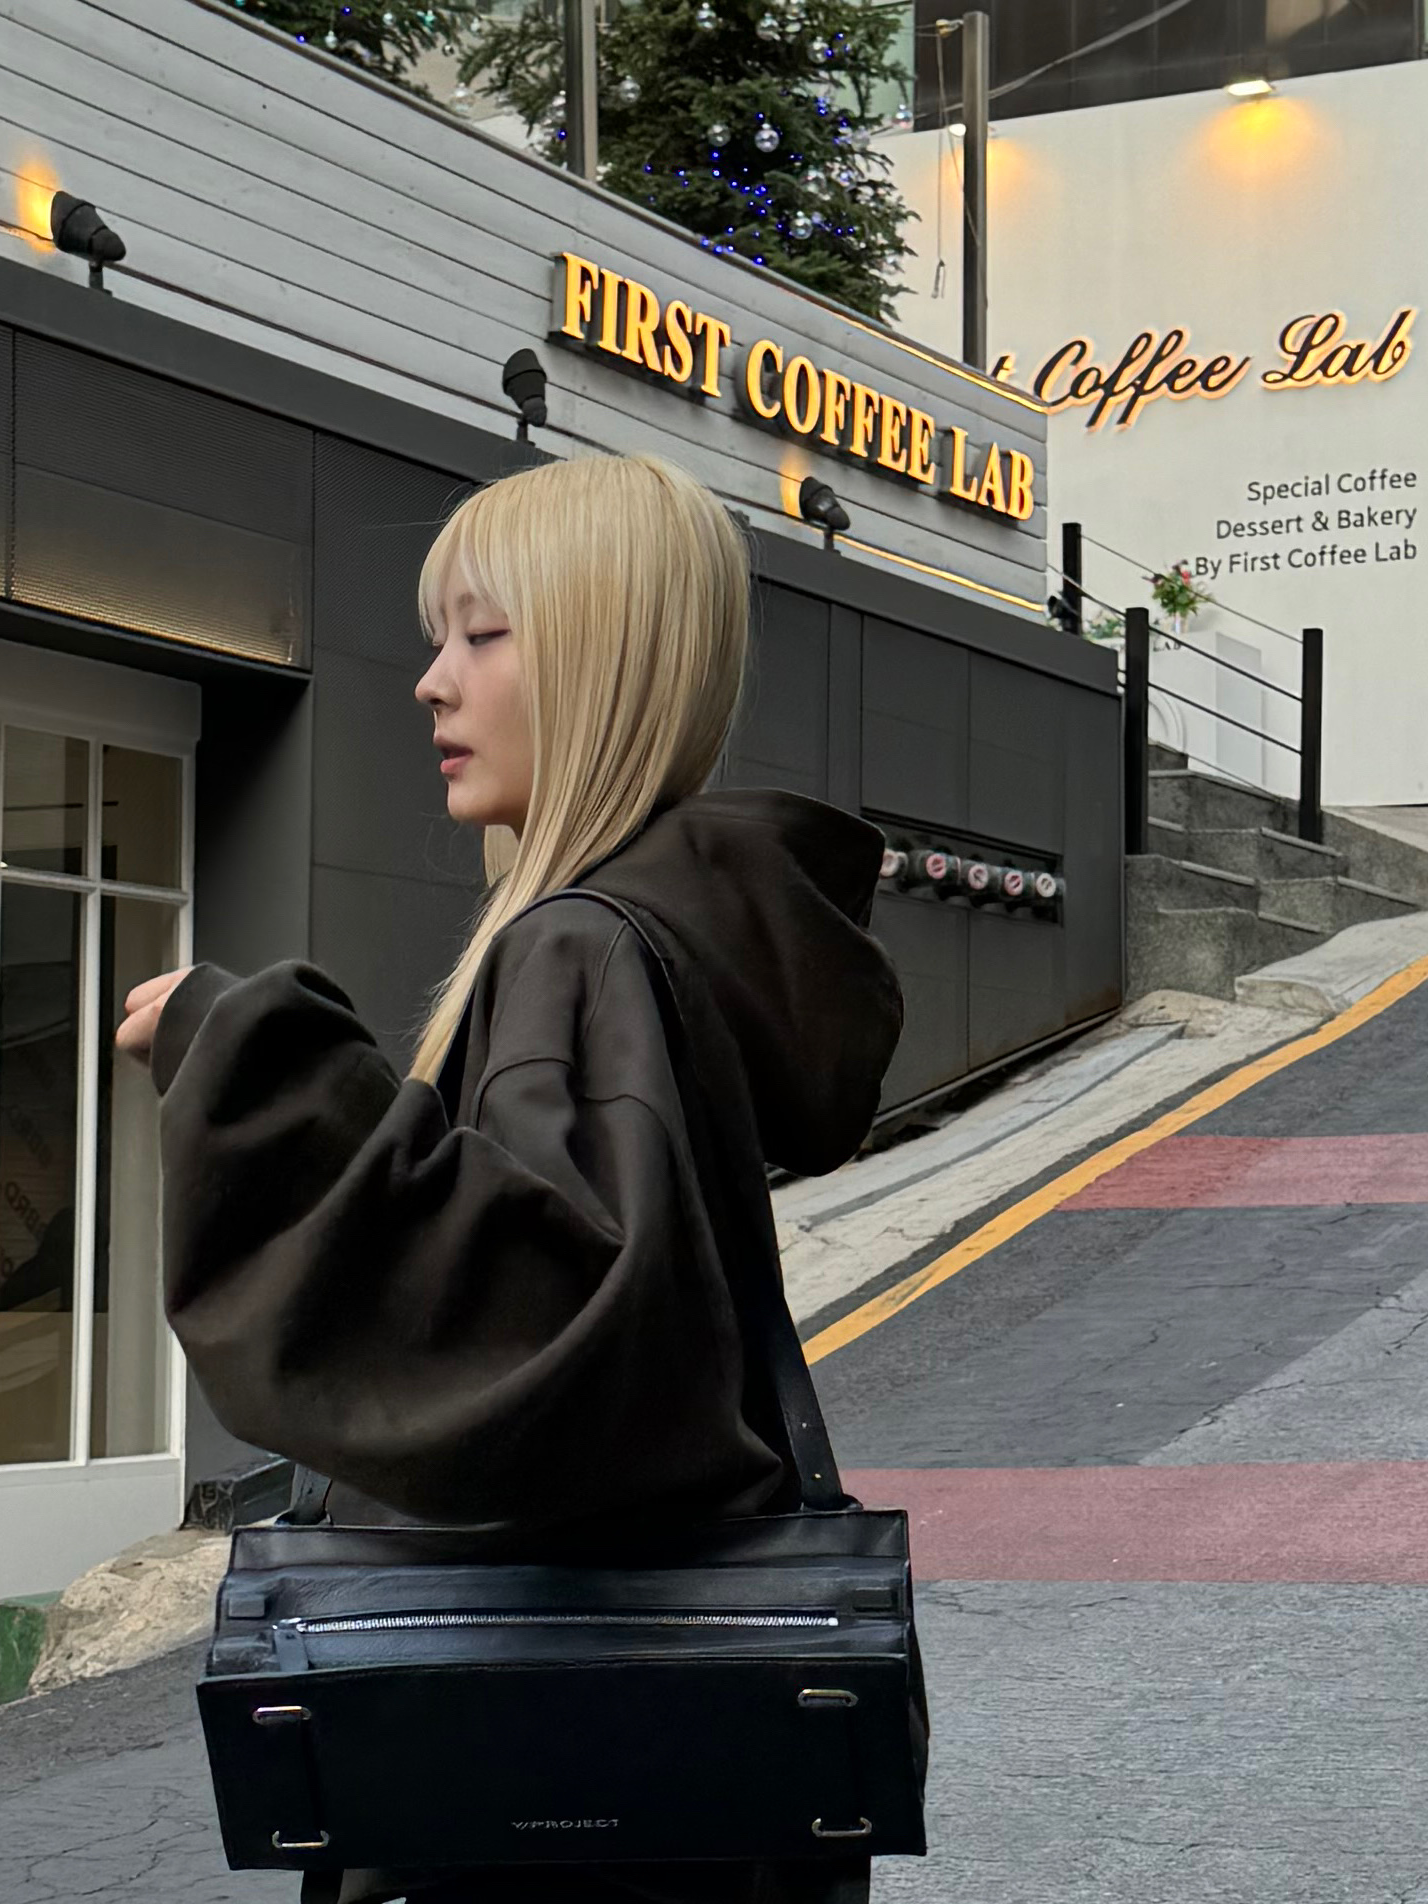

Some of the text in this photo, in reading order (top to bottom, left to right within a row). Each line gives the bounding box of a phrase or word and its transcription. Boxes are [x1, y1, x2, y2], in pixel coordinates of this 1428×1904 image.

[556, 252, 1035, 522] FIRST COFFEE LAB
[1033, 306, 1419, 431] Coffee Lab
[1247, 468, 1417, 506] Special Coffee
[1216, 505, 1417, 540] Dessert & Bakery
[1195, 539, 1417, 579] By First Coffee Lab
